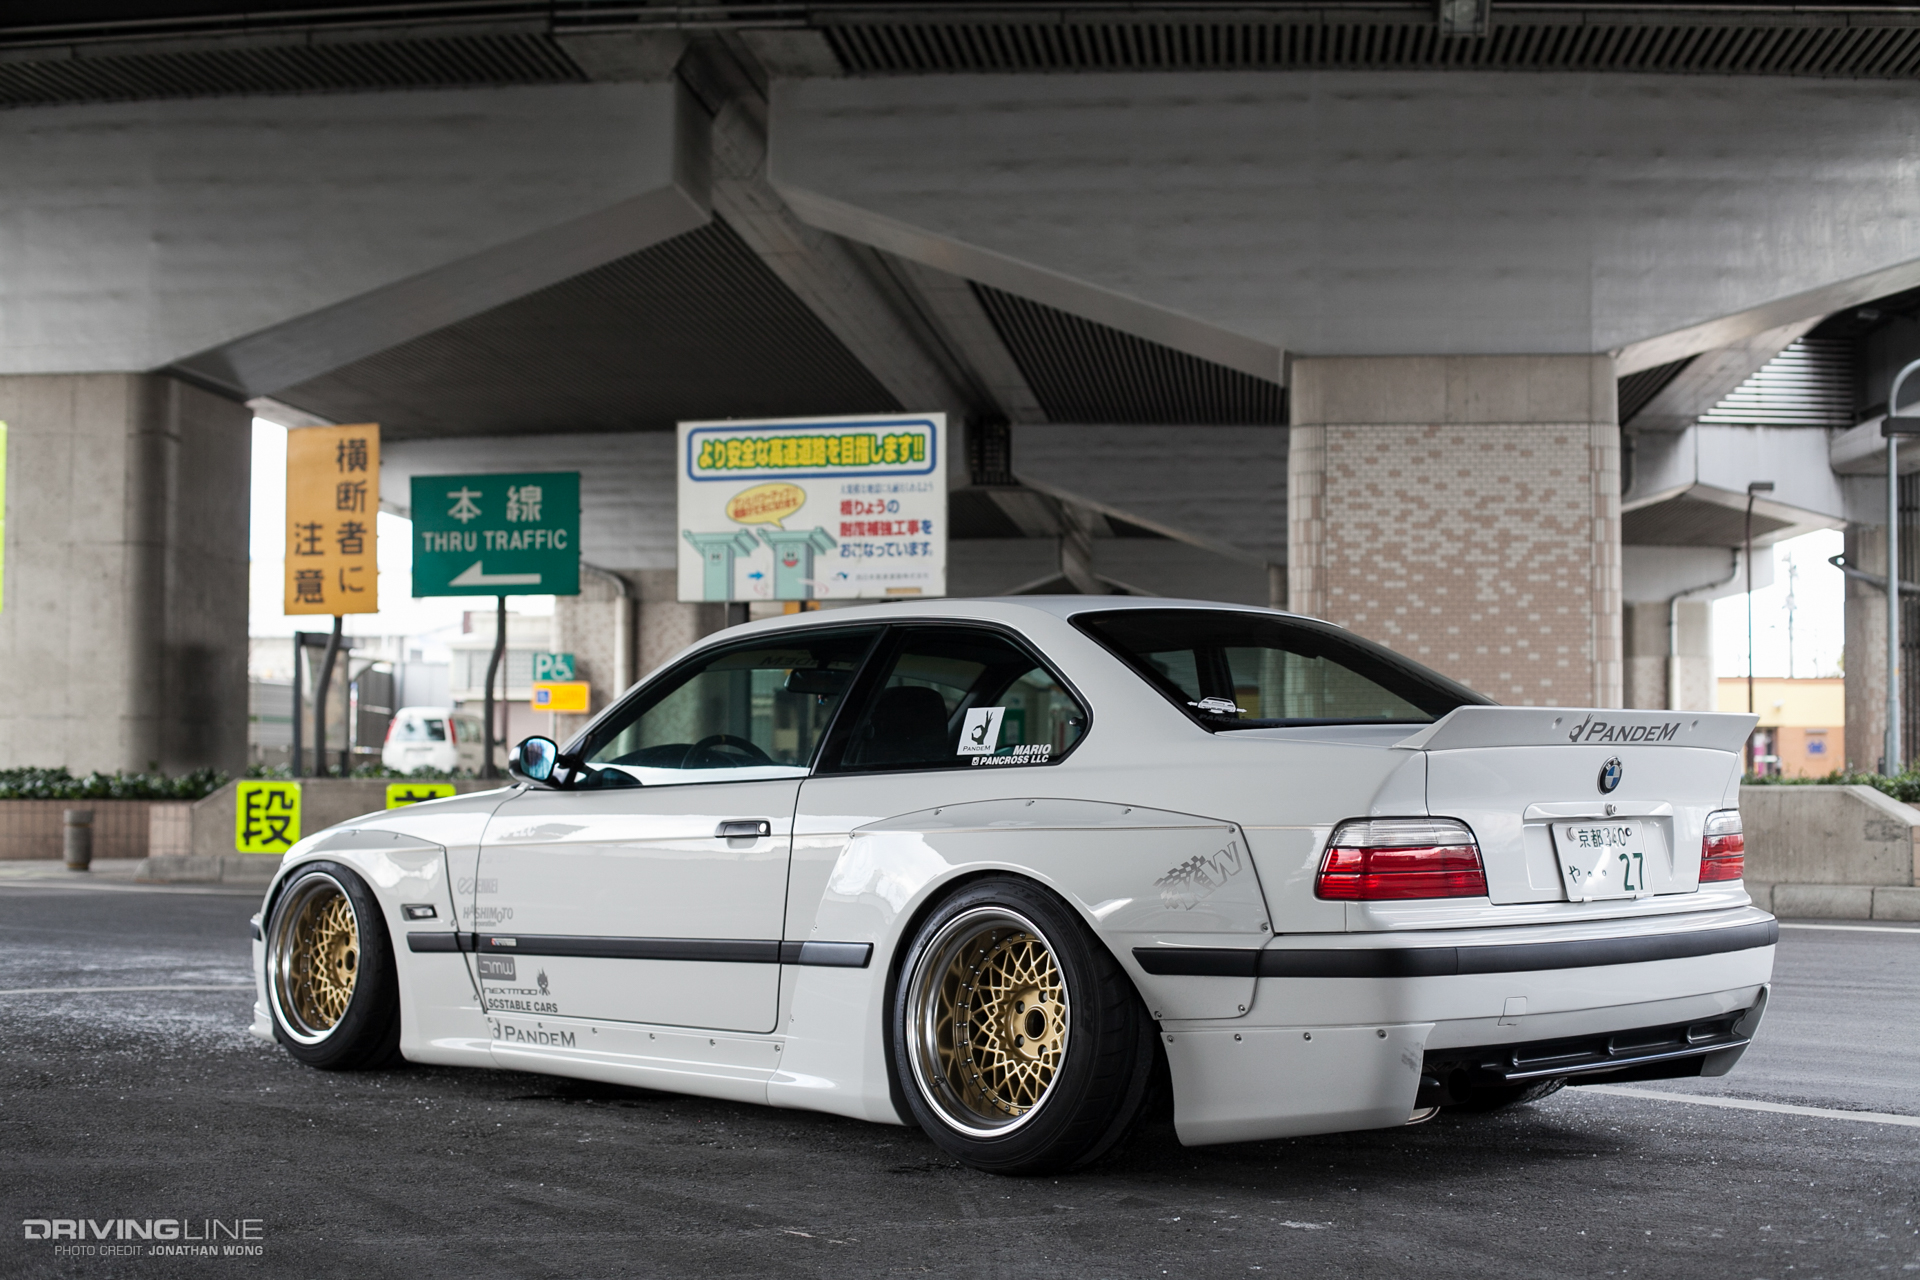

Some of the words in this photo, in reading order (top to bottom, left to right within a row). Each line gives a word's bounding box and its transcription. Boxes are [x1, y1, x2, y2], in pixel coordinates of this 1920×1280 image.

[335, 438, 369, 594] 横断者に
[447, 485, 543, 524] 本線
[422, 531, 478, 553] THRU
[483, 528, 568, 551] TRAFFIC
[294, 520, 326, 604] 注意
[535, 654, 553, 680] P
[980, 755, 1029, 766] PANCROSS
[1030, 755, 1049, 763] LLC
[1012, 744, 1052, 756] MARIO
[243, 788, 294, 846] 段
[1618, 852, 1644, 892] 27
[463, 904, 514, 923] HASHIMOTO
[533, 1001, 558, 1013] CARS
[504, 1025, 576, 1048] PANDEM
